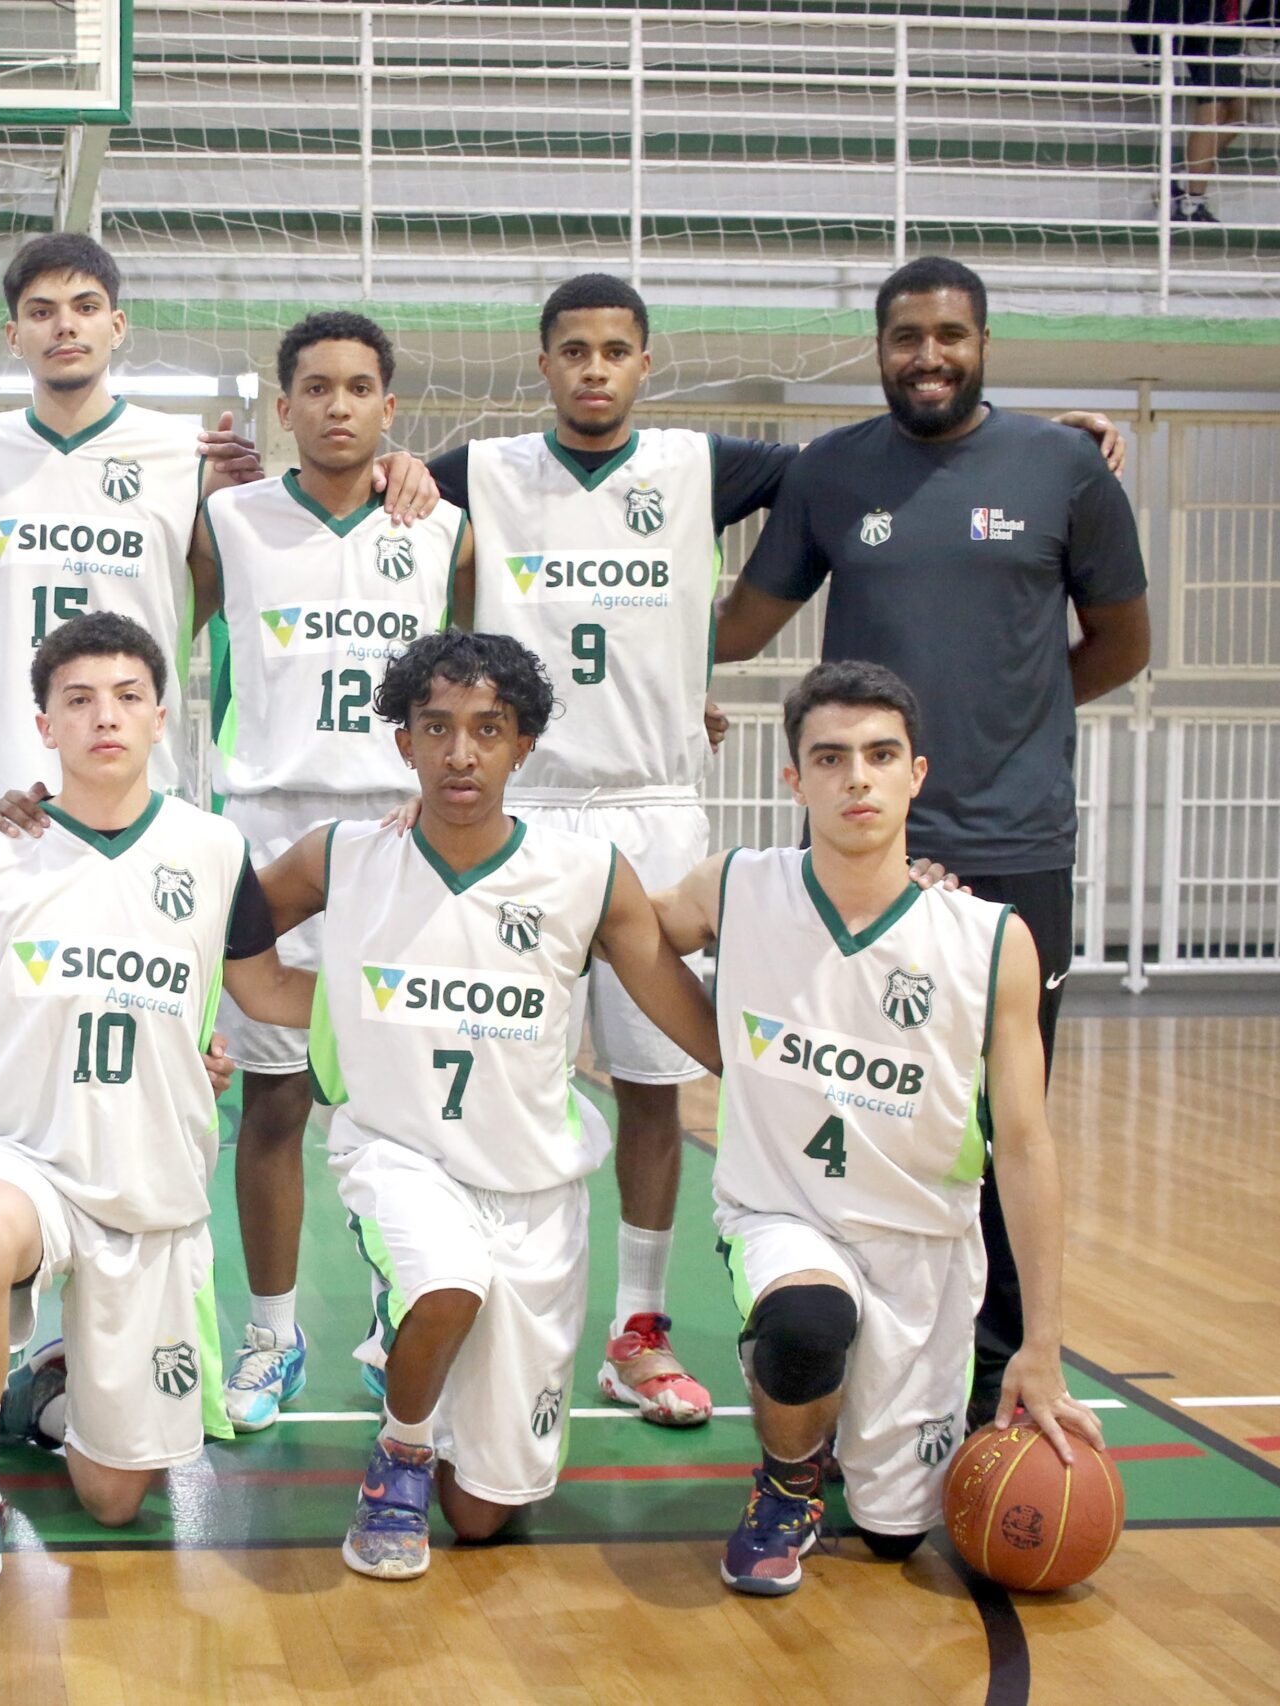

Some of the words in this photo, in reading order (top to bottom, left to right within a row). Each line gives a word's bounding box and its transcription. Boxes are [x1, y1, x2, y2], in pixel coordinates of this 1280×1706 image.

[16, 524, 143, 558] SICOOB
[61, 559, 139, 578] Agrocredi
[545, 560, 668, 587] SICOOB
[591, 594, 667, 609] Agrocredi
[305, 609, 417, 640] SICOOB
[570, 624, 606, 684] 9
[315, 669, 372, 733] 12
[61, 946, 191, 994] SICOOB
[104, 988, 183, 1018] Agrocredi
[404, 977, 544, 1018] SICOOB
[72, 1012, 137, 1083] 10
[457, 1019, 538, 1041] Agrocredi
[780, 1033, 925, 1094] SICOOB
[432, 1050, 473, 1120] 7
[823, 1084, 914, 1118] Agrocredi
[802, 1115, 847, 1178] 4
